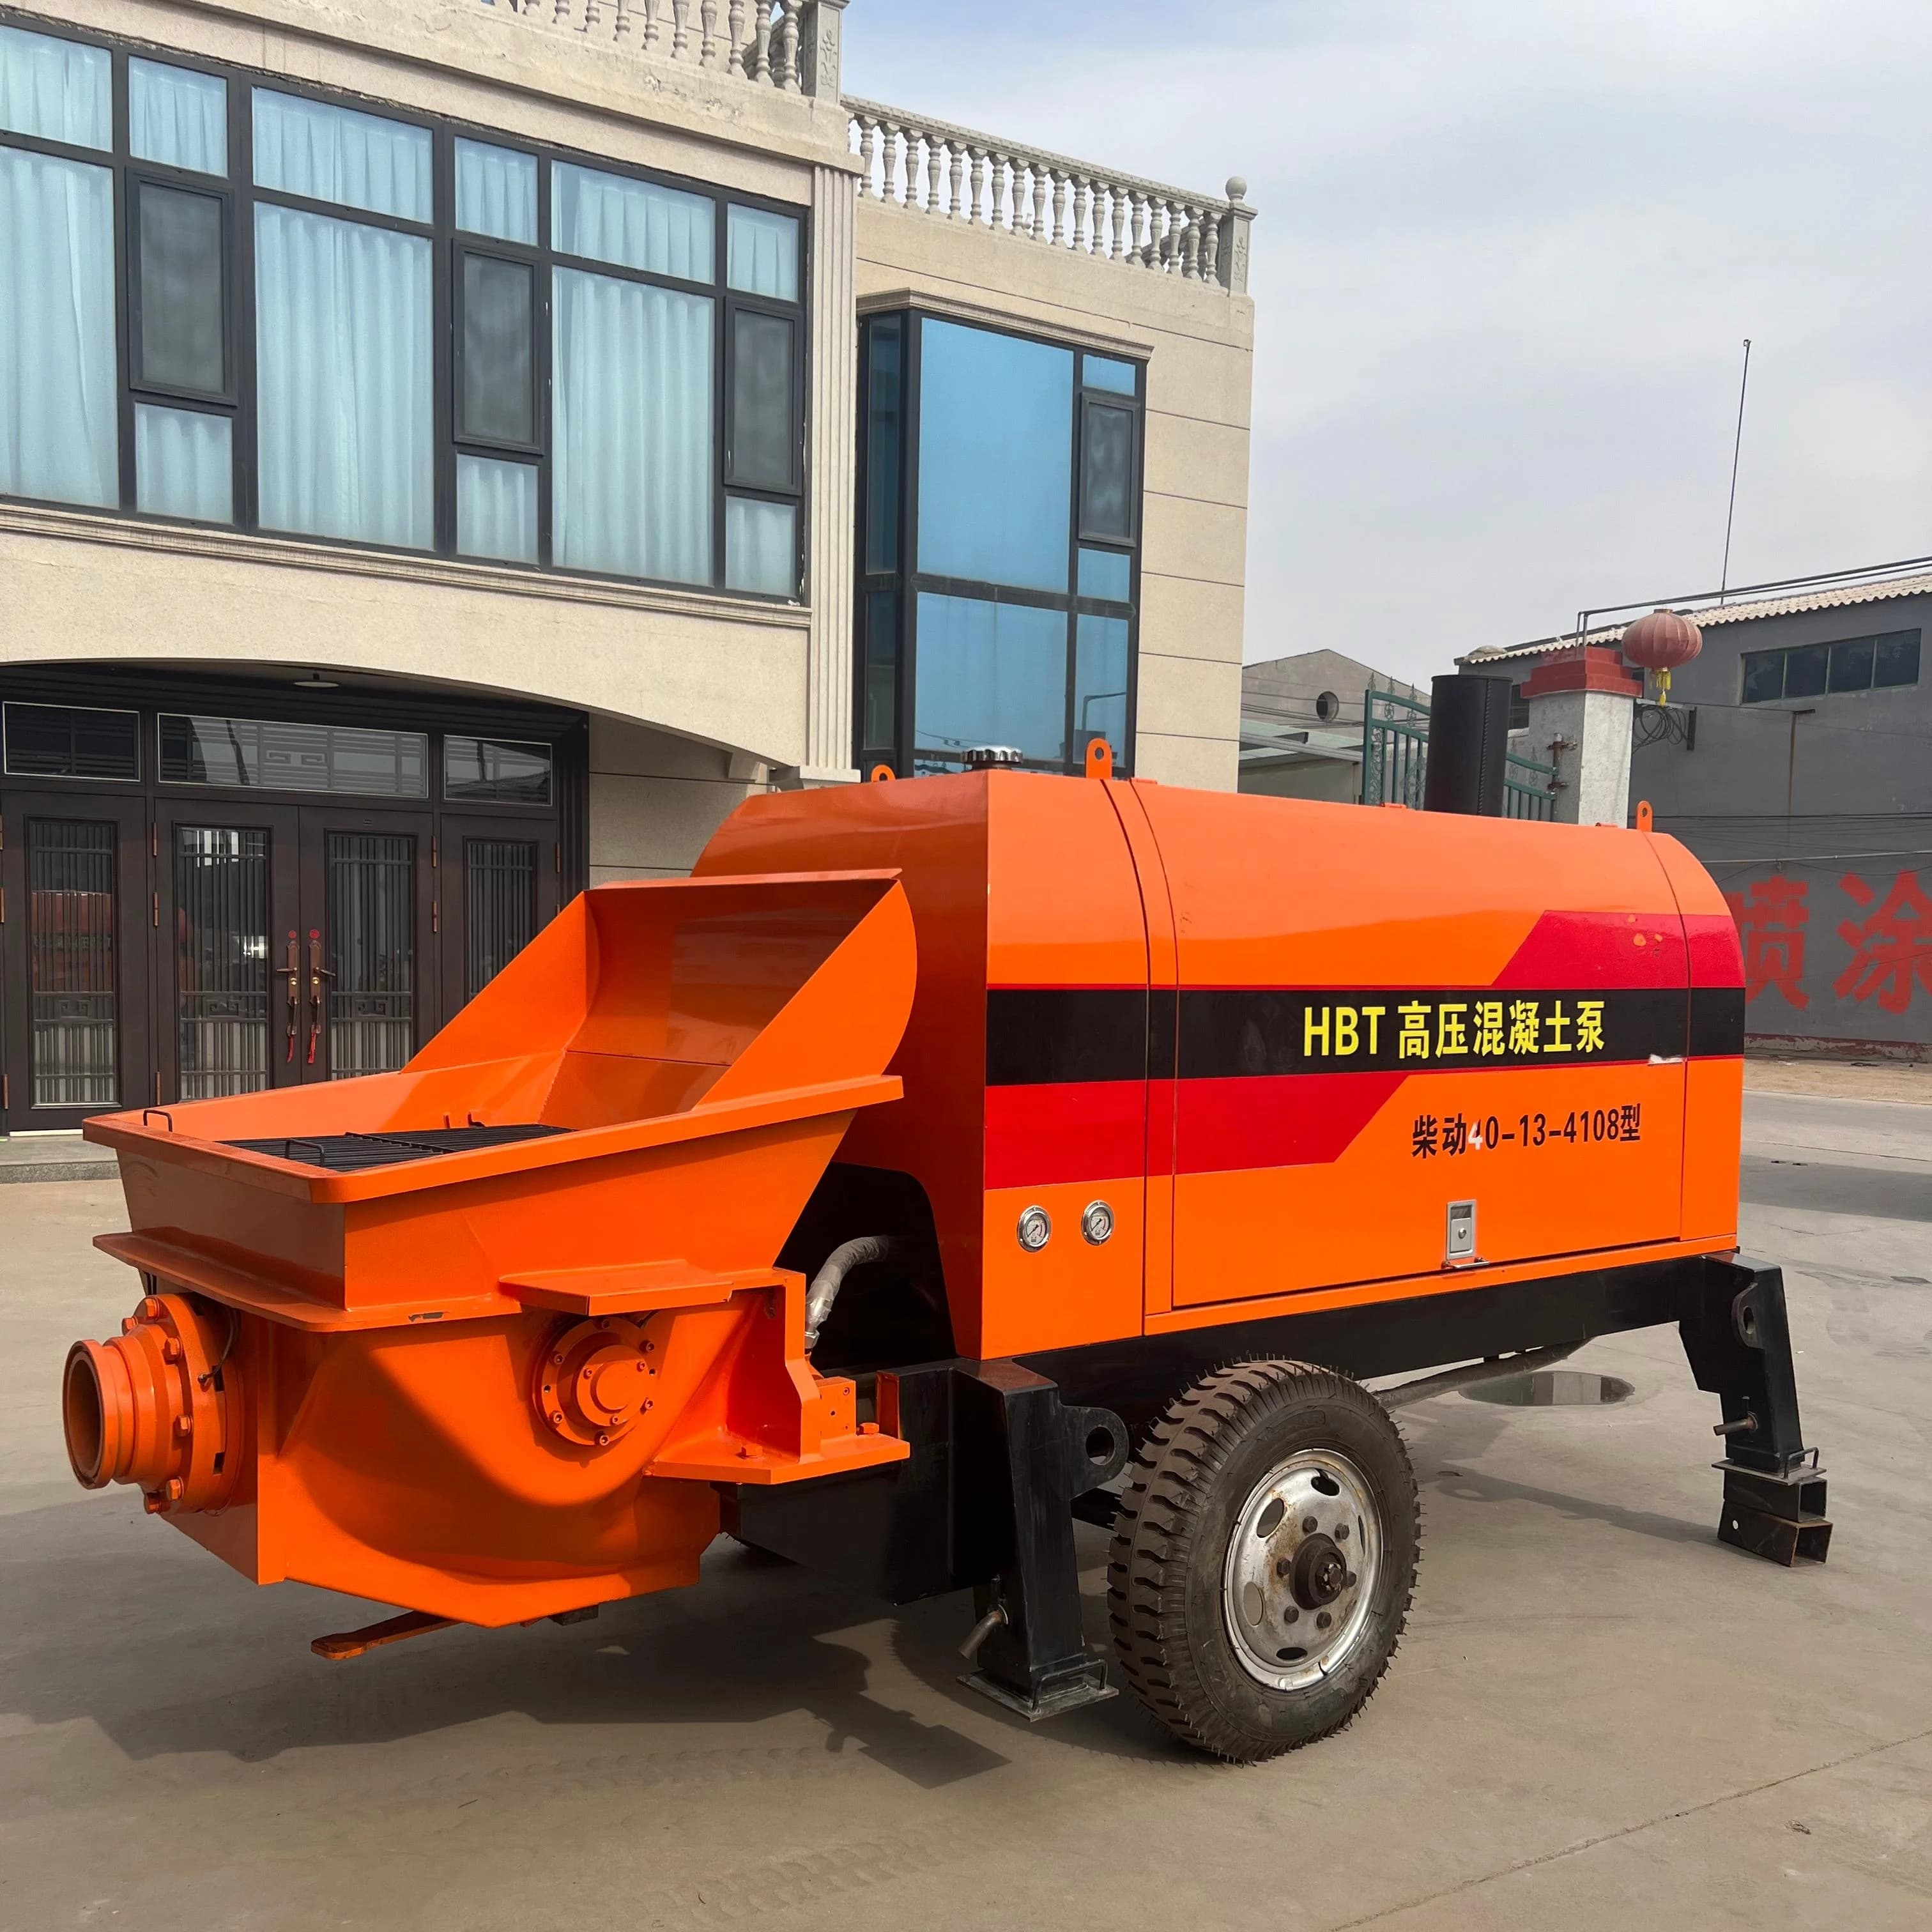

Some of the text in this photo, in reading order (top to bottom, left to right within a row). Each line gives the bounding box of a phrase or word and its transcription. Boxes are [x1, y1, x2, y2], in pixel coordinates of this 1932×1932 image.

[1303, 1000, 1605, 1059] HBT 高压混凝土泵
[1411, 1103, 1641, 1159] 柴动40-13-4108型
